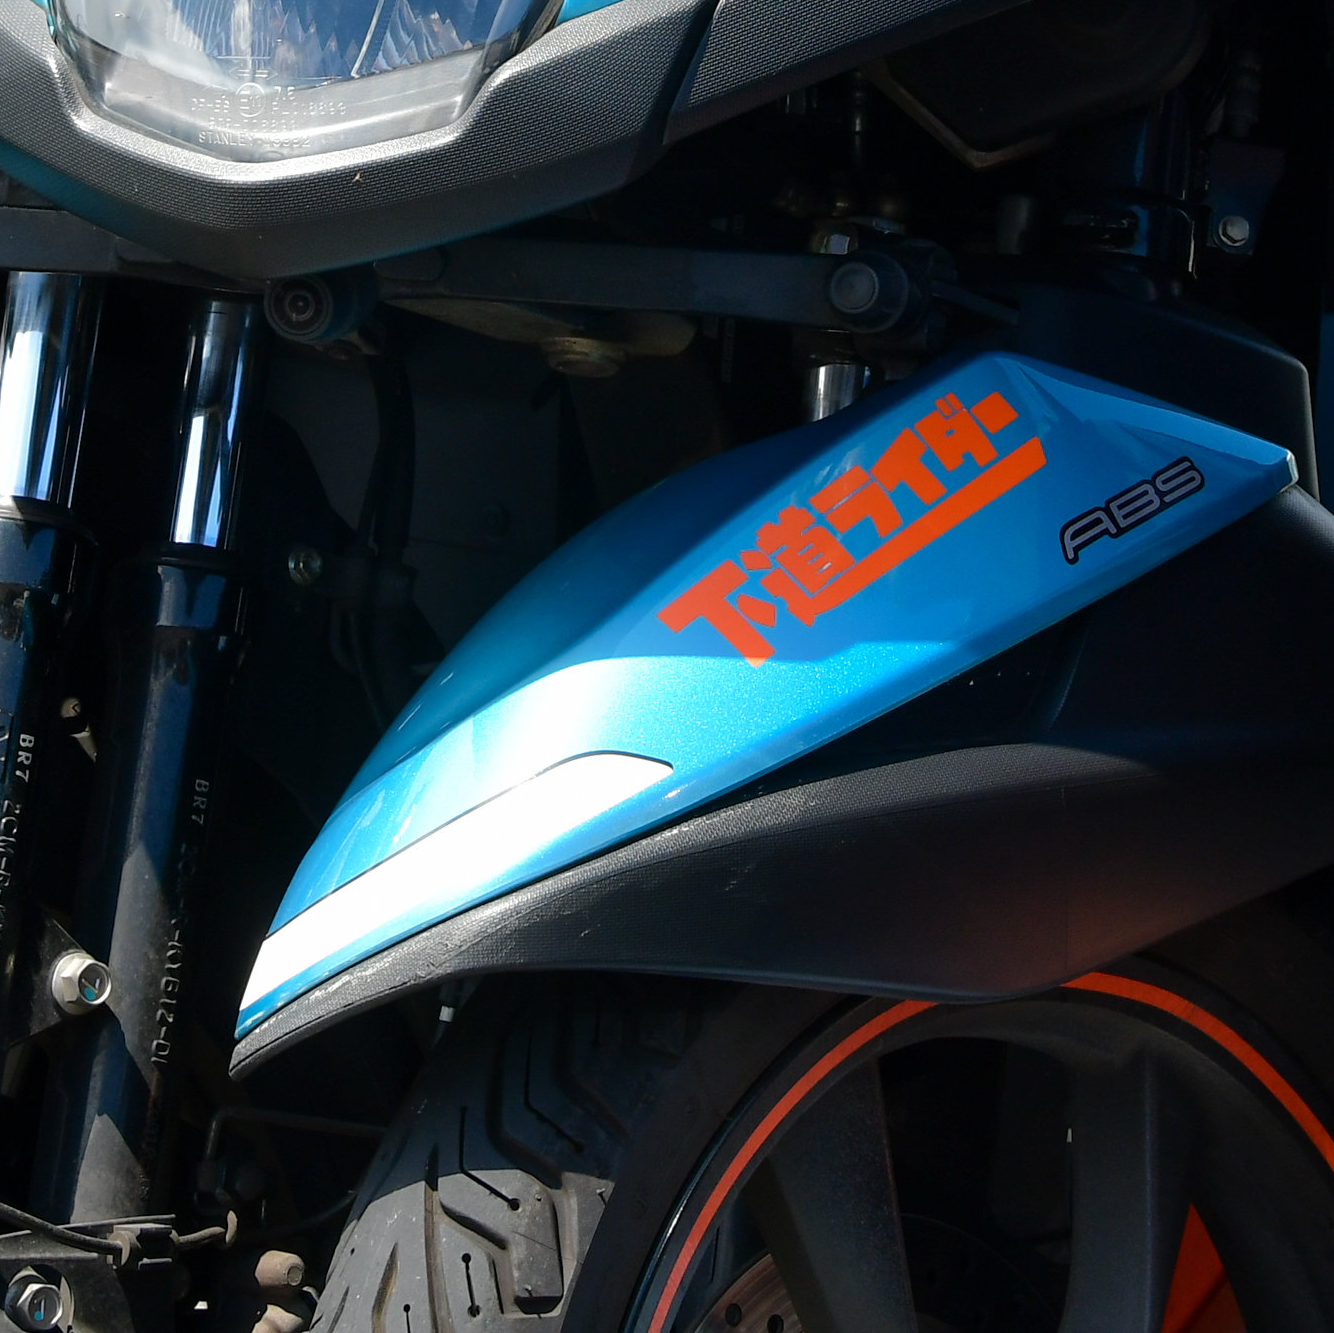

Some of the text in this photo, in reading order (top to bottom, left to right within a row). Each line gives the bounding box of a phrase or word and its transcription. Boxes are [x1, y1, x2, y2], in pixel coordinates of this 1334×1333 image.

[656, 391, 1048, 669] 下道ライダー
[1063, 459, 1203, 561] ABS
[15, 732, 35, 783] BR7
[190, 777, 210, 826] BR7
